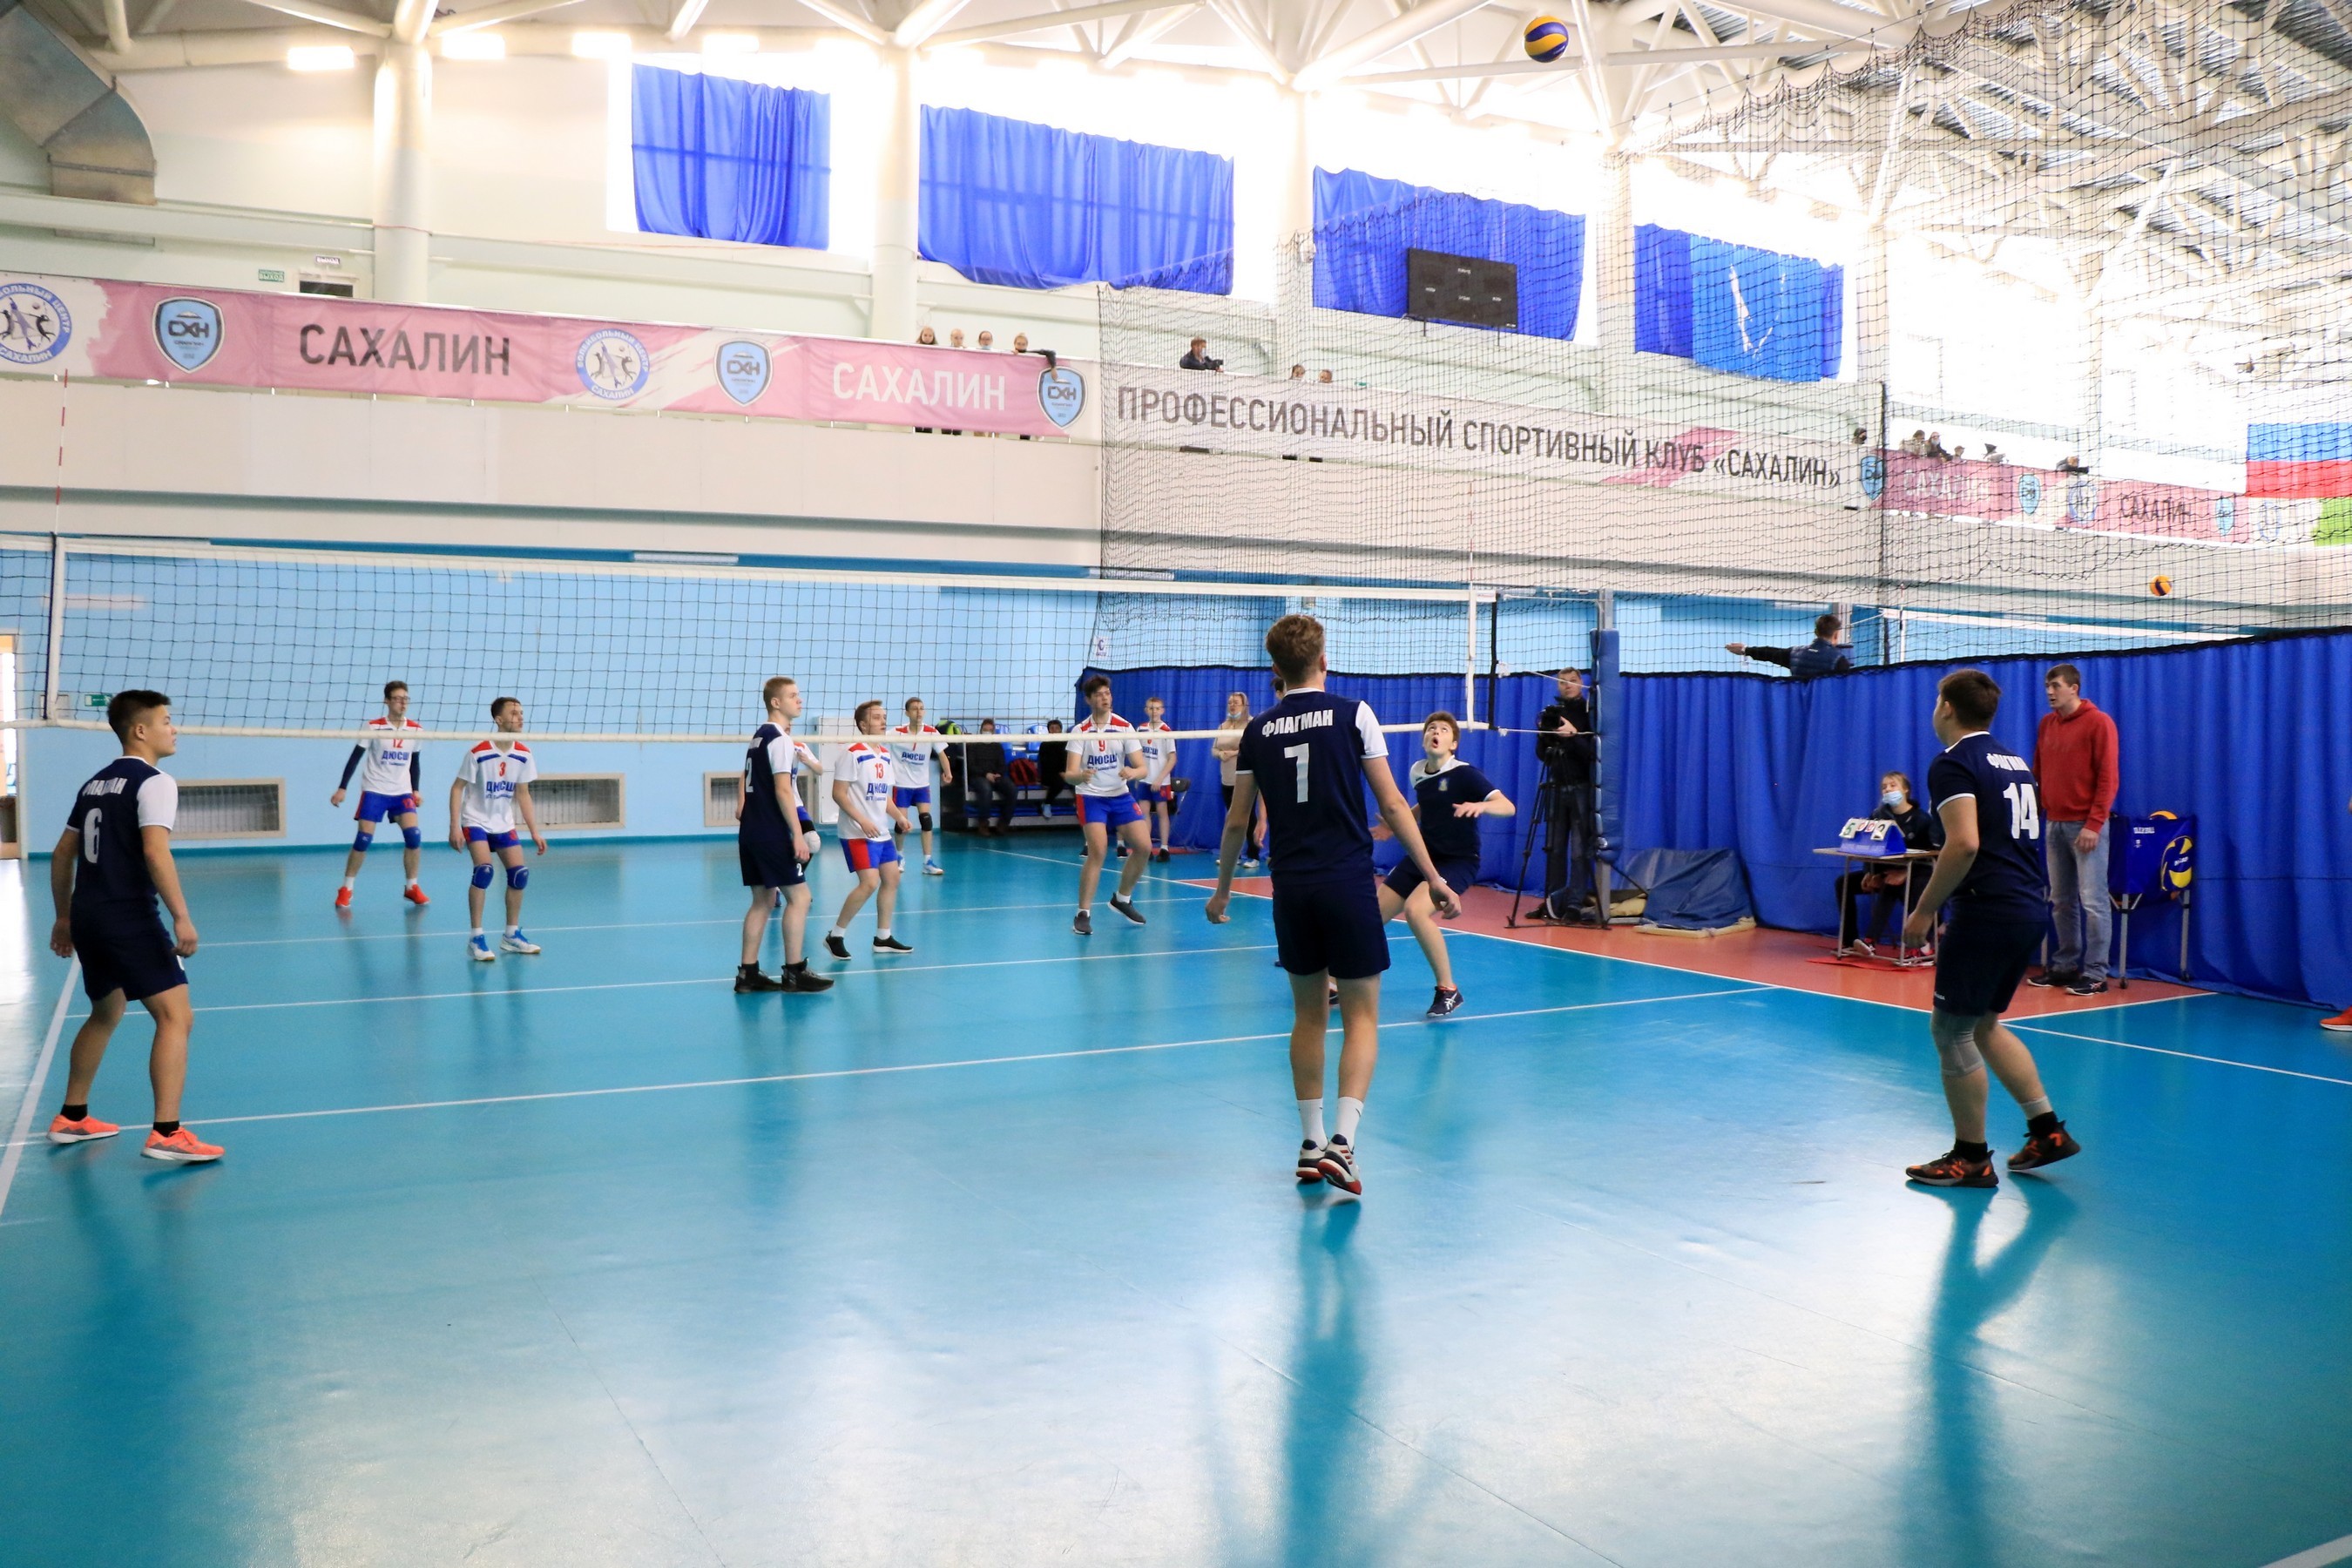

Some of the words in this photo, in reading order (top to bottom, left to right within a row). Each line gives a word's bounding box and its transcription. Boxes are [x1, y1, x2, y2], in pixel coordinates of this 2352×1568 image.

[299, 323, 510, 376] САХАЛИН
[832, 362, 1006, 411] САХАЛИН
[1118, 386, 1453, 449] ПРОФЕССИОНАЛЬНЫЙ
[1463, 419, 1638, 467] СПОРТИВНЫЙ
[1645, 442, 1706, 473] КЛУБ
[1713, 449, 1842, 488] «САХАЛИН»
[2120, 494, 2192, 524] САХАЛИН
[1261, 709, 1334, 738] ФЛАГМАН
[382, 750, 410, 760] ДЮСШ
[499, 761, 507, 777] 3
[875, 763, 884, 779] 13
[901, 751, 926, 760] ДЮСШ
[1087, 753, 1118, 766] ДЮСШ
[746, 757, 754, 793] 2
[1284, 742, 1309, 803] 7
[2003, 782, 2040, 840] 14
[84, 808, 103, 864] 6
